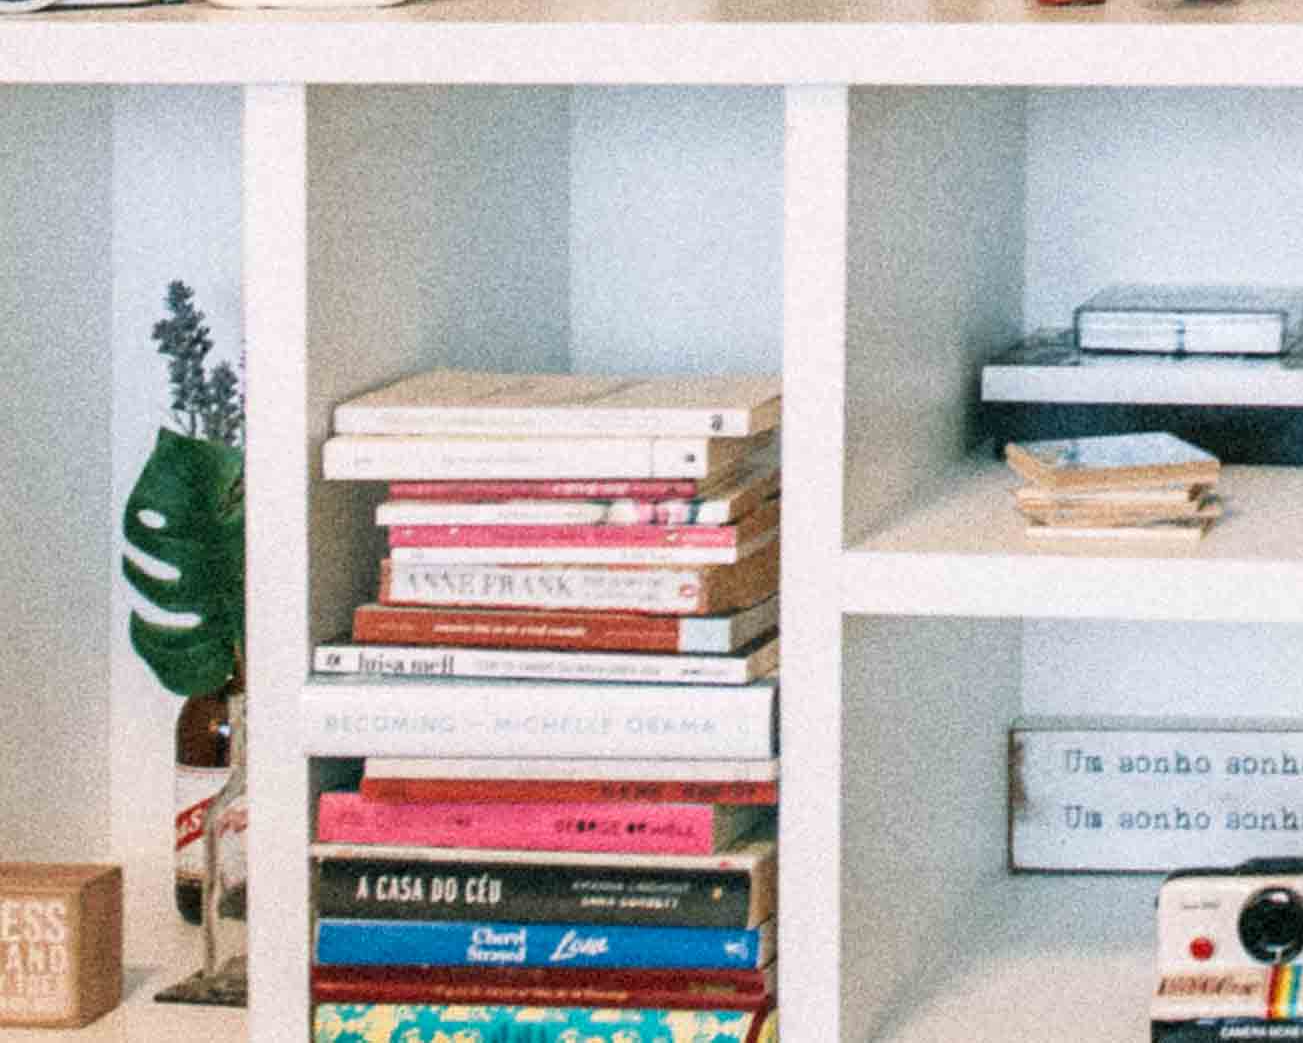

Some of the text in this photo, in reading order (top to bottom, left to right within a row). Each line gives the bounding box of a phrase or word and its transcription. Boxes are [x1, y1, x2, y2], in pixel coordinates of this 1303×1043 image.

[481, 571, 574, 599] FRANK
[325, 717, 718, 735] BECOMING MICHELLE OBAMA
[1064, 750, 1102, 773] Um
[1118, 749, 1211, 774] sonho
[1064, 806, 1102, 830] Um
[1118, 805, 1211, 831] sonho
[357, 874, 501, 904] A CASA DO CÉU
